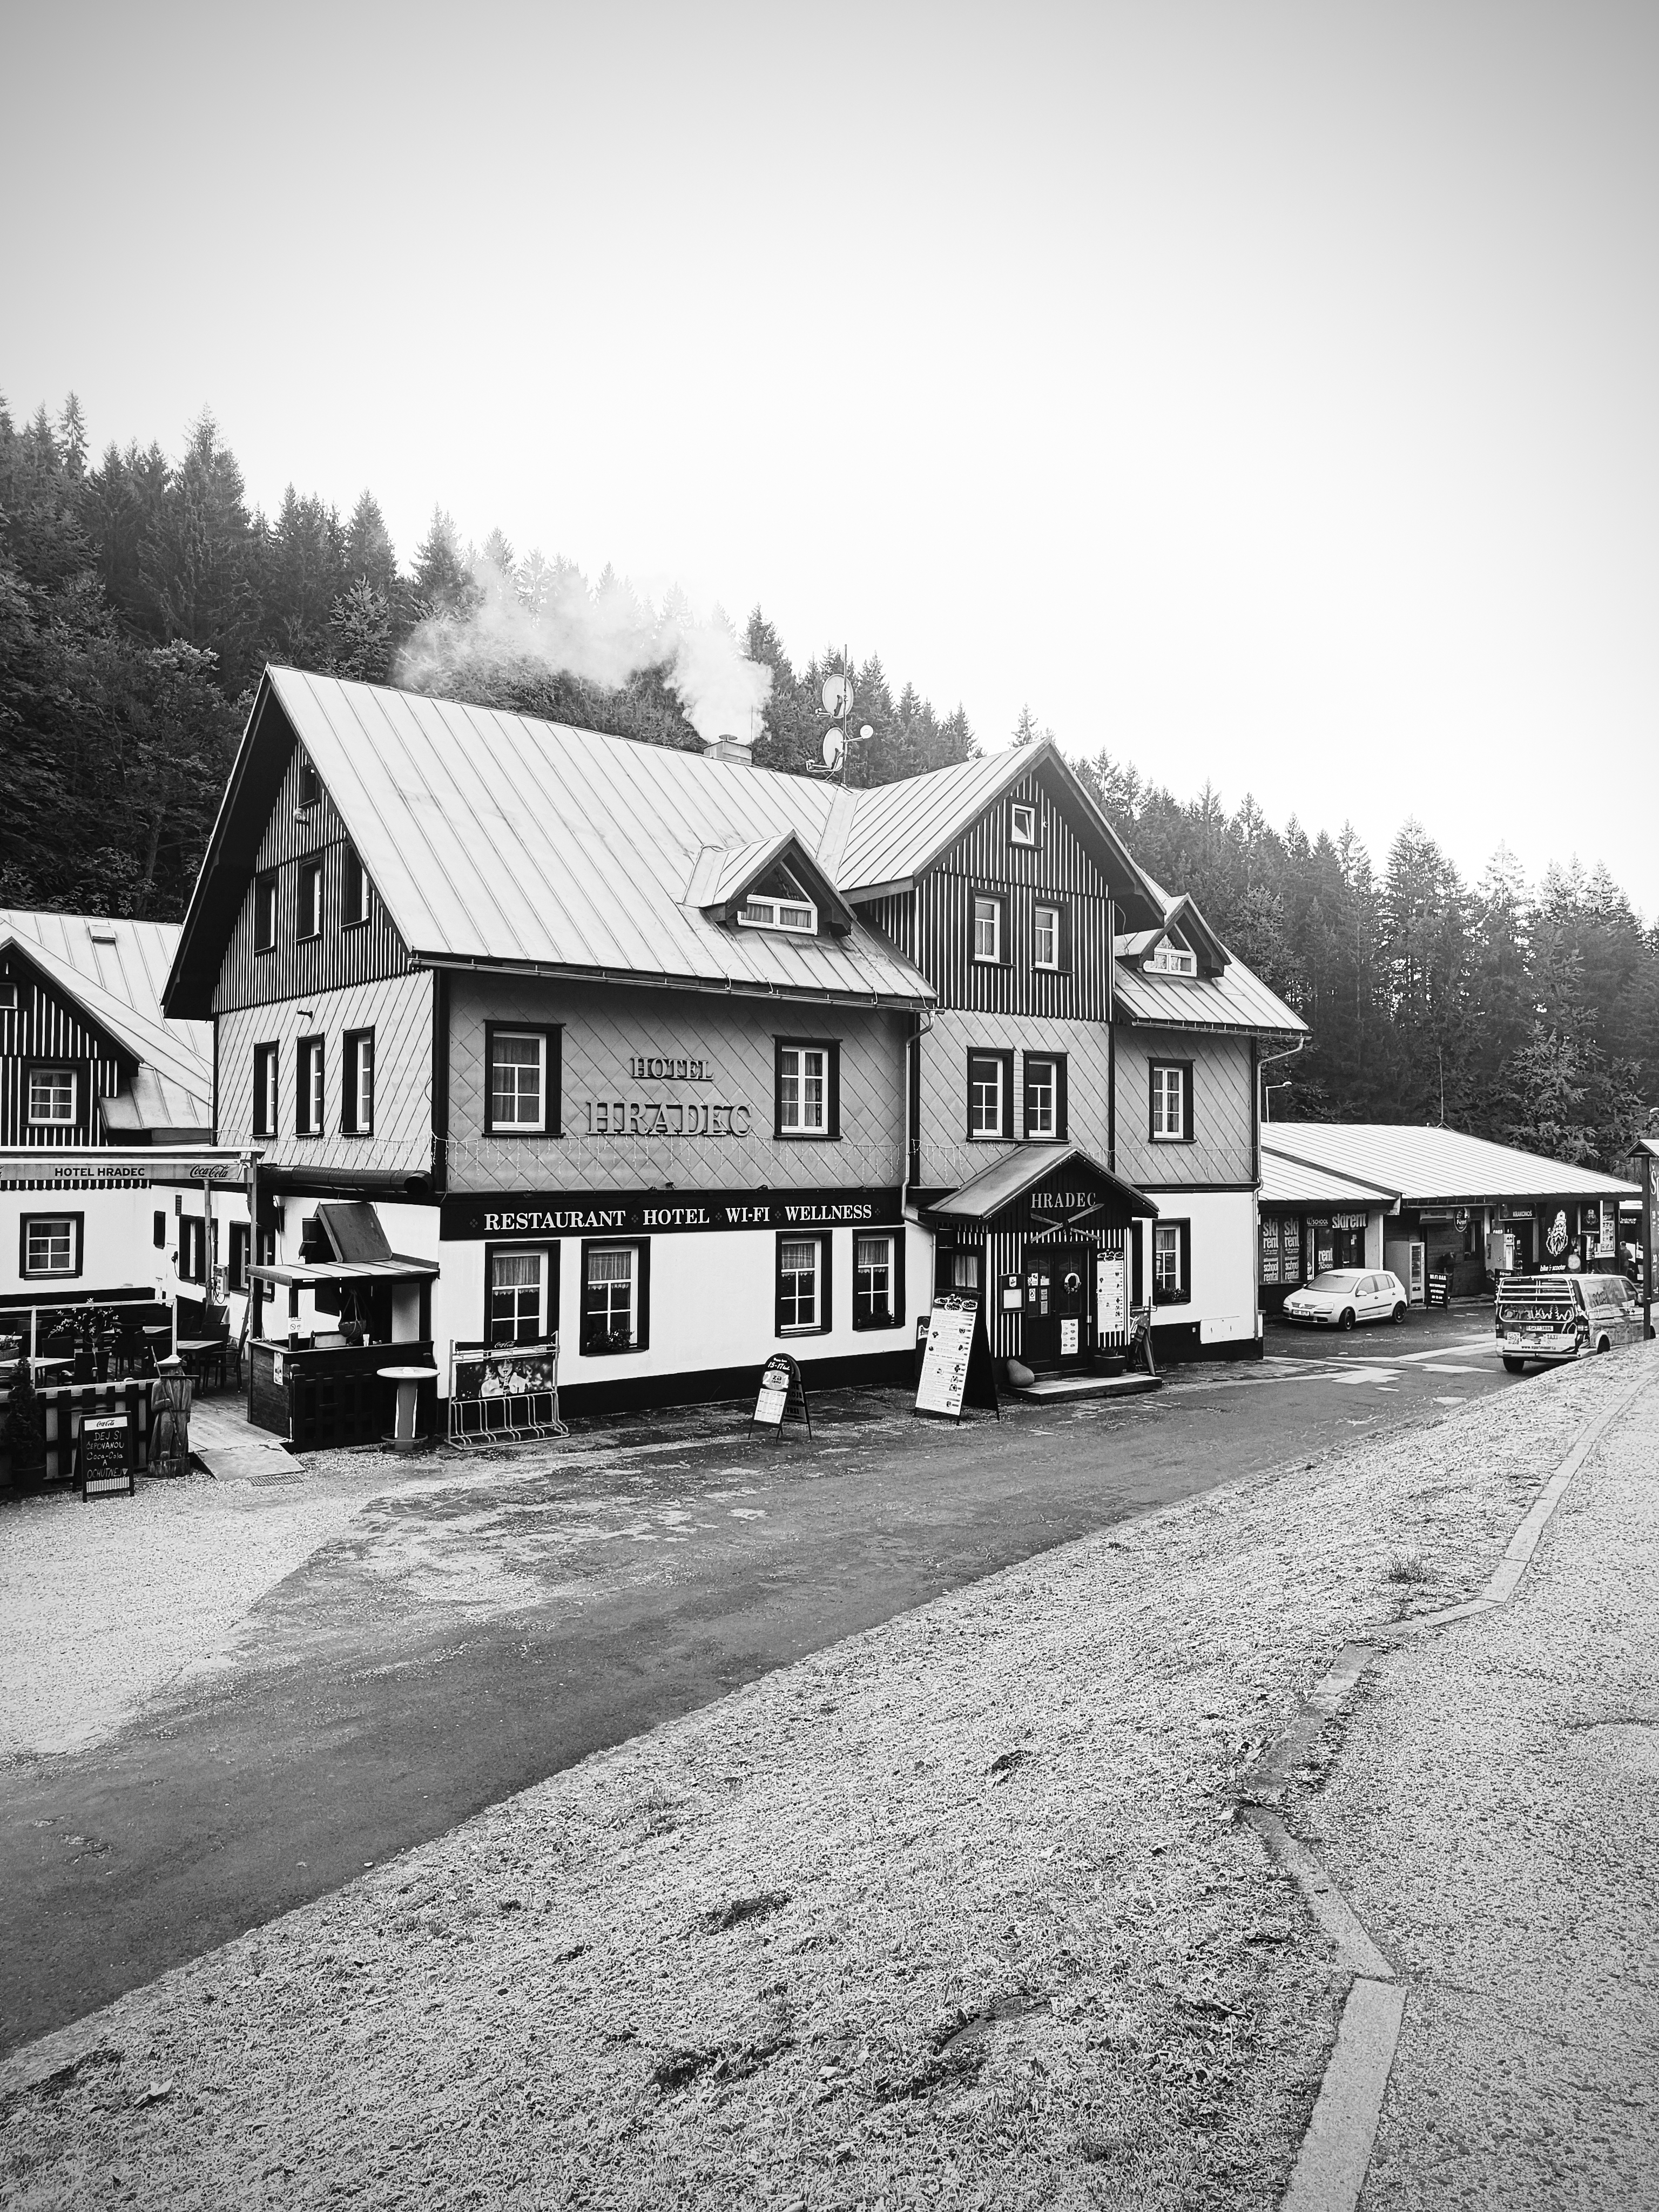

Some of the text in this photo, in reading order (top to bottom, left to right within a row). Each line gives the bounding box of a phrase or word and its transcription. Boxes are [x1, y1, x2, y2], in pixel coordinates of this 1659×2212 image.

[630, 1057, 714, 1081] HOTEL
[586, 1101, 752, 1137] HRADEC
[55, 1168, 145, 1177] HOTEL HRADEC
[190, 1165, 231, 1178] Coca-Cola
[1030, 1192, 1096, 1209] HRADEC
[484, 1204, 872, 1231] RESTAURANT HOTEL WI-FI WELLNESS
[1263, 1236, 1279, 1249] rent
[1284, 1236, 1299, 1247] rent
[762, 1371, 771, 1385] 2
[781, 1374, 789, 1389] 1
[93, 1430, 122, 1441] DEJ SI
